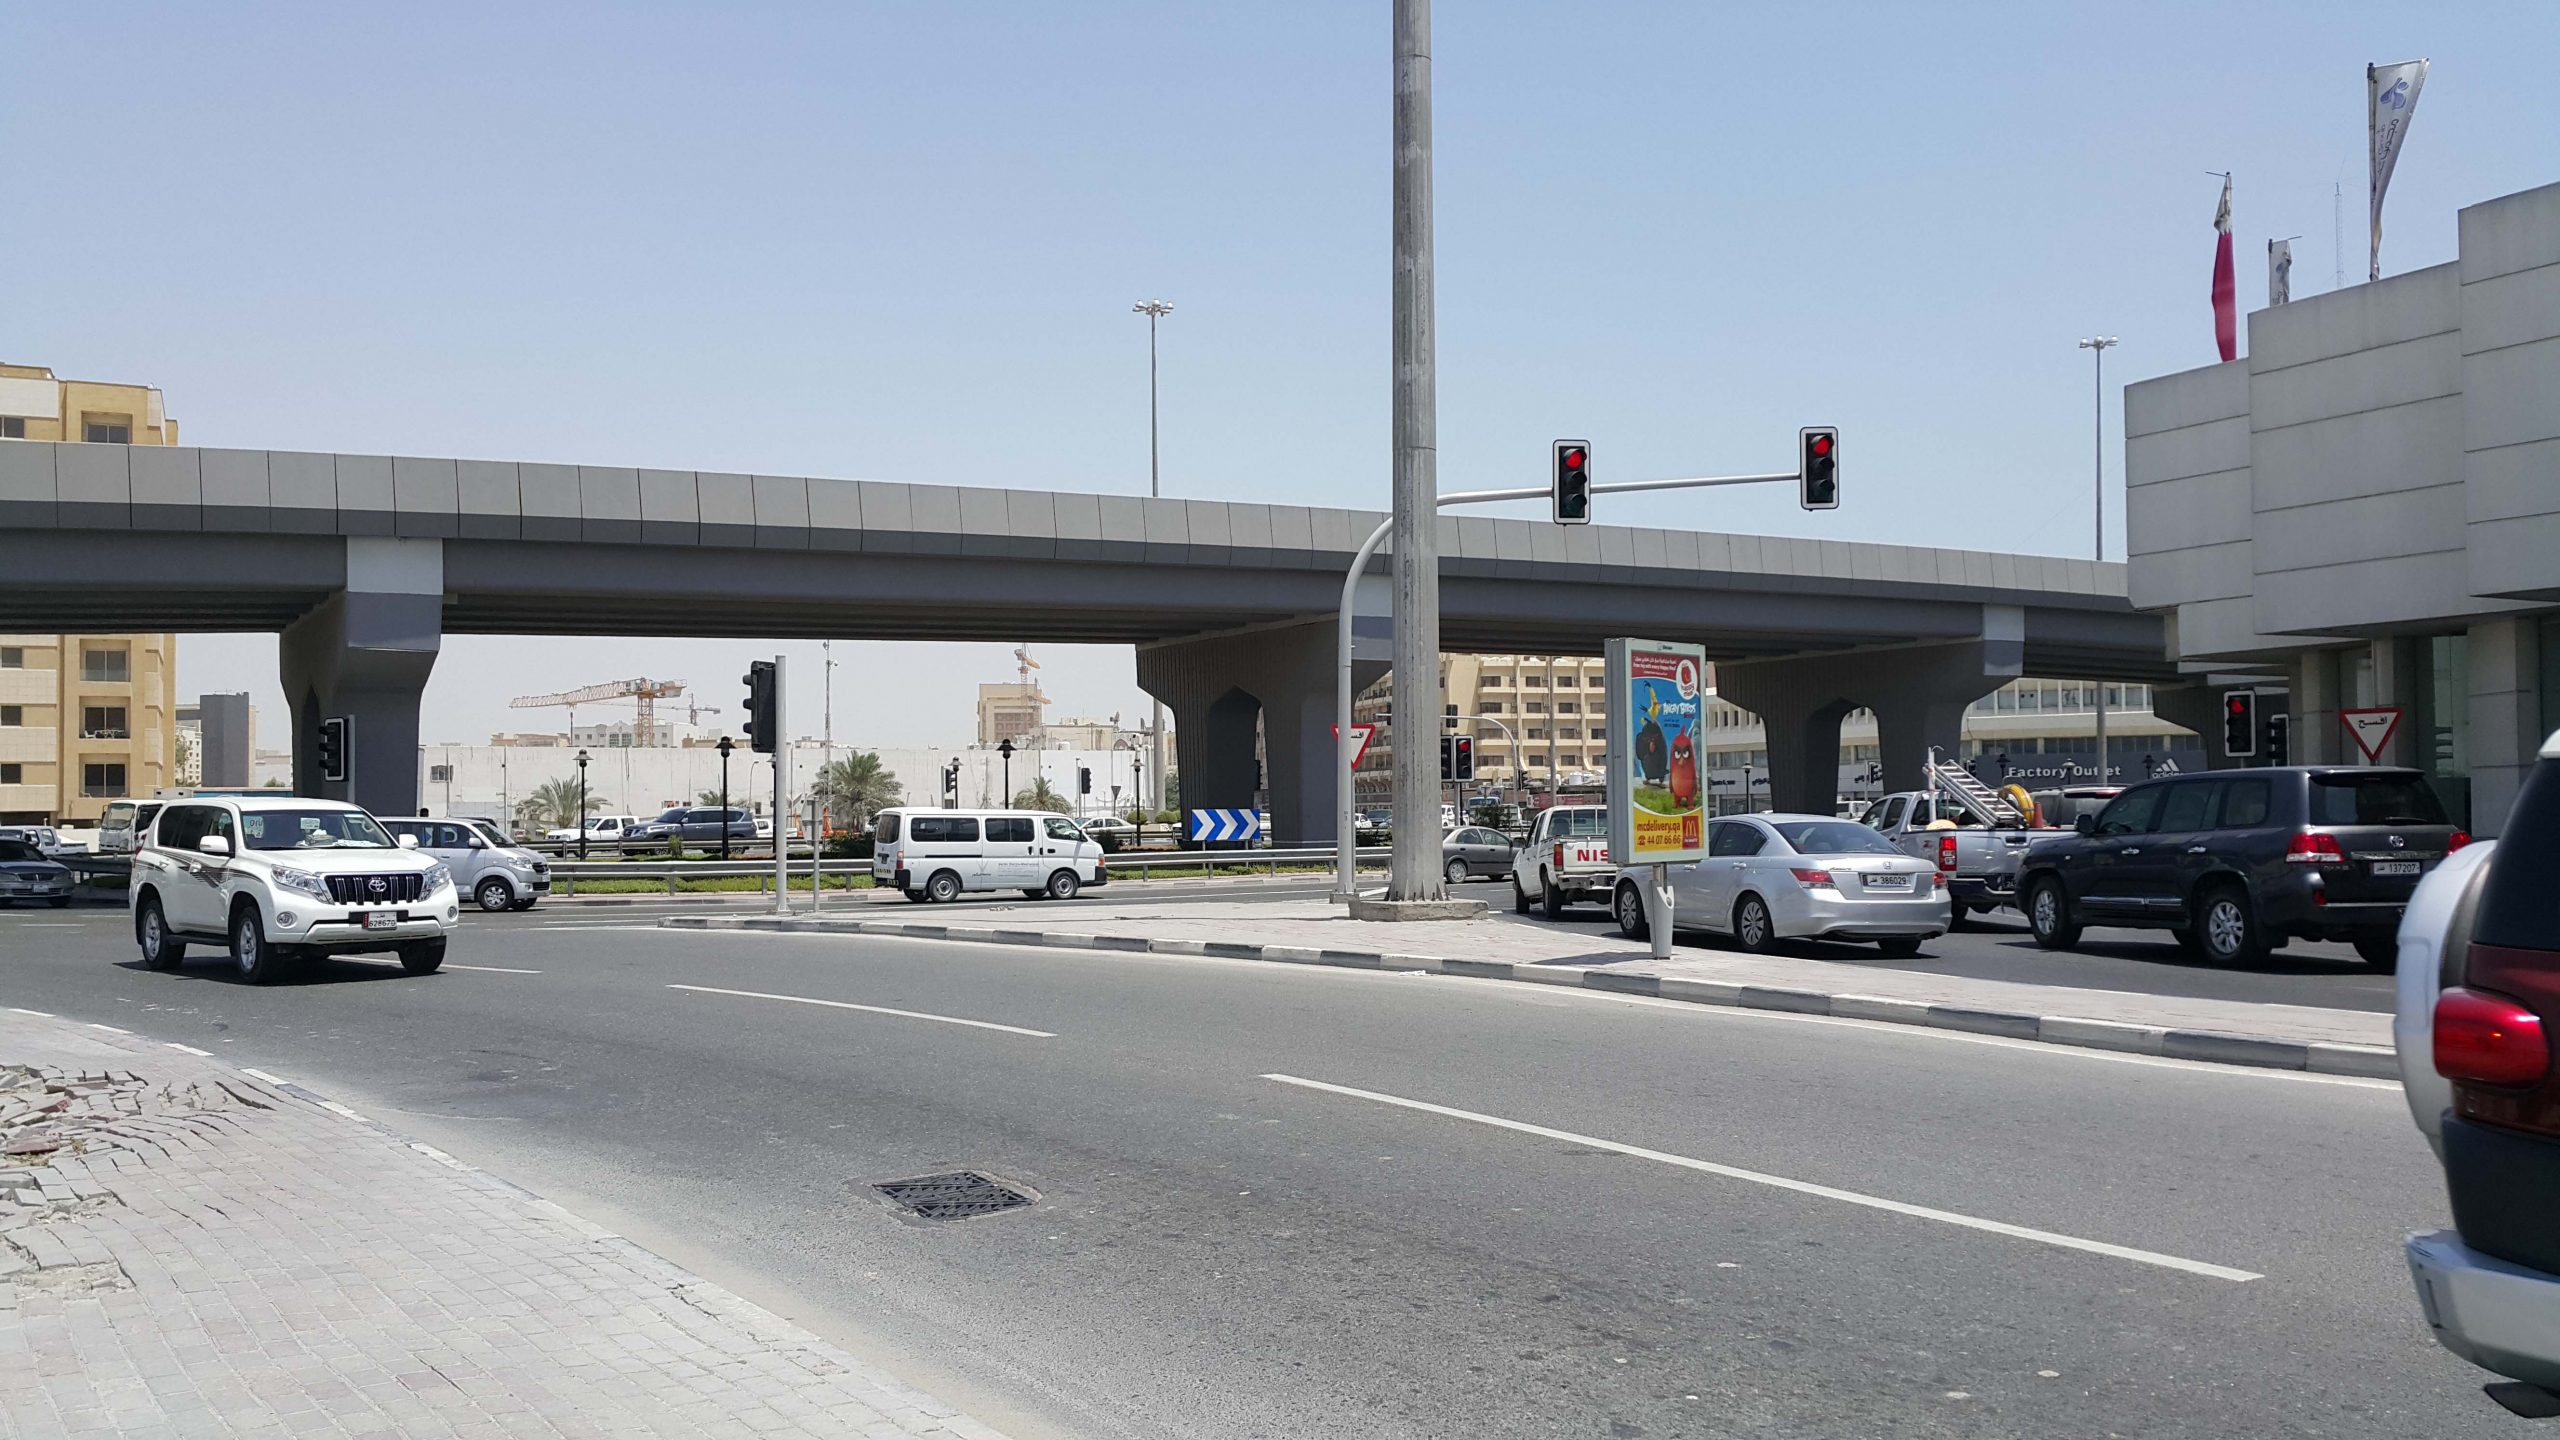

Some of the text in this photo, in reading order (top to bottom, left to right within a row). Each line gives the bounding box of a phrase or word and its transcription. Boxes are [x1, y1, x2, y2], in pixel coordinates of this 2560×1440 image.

[2358, 716, 2388, 729] افسح
[1350, 731, 1365, 739] افس
[2008, 765, 2121, 779] Factory Outet
[1636, 819, 1681, 833] mcdelivery.qa
[1647, 835, 1655, 845] 44
[1577, 849, 1608, 862] NIS
[2389, 863, 2416, 873] 137207
